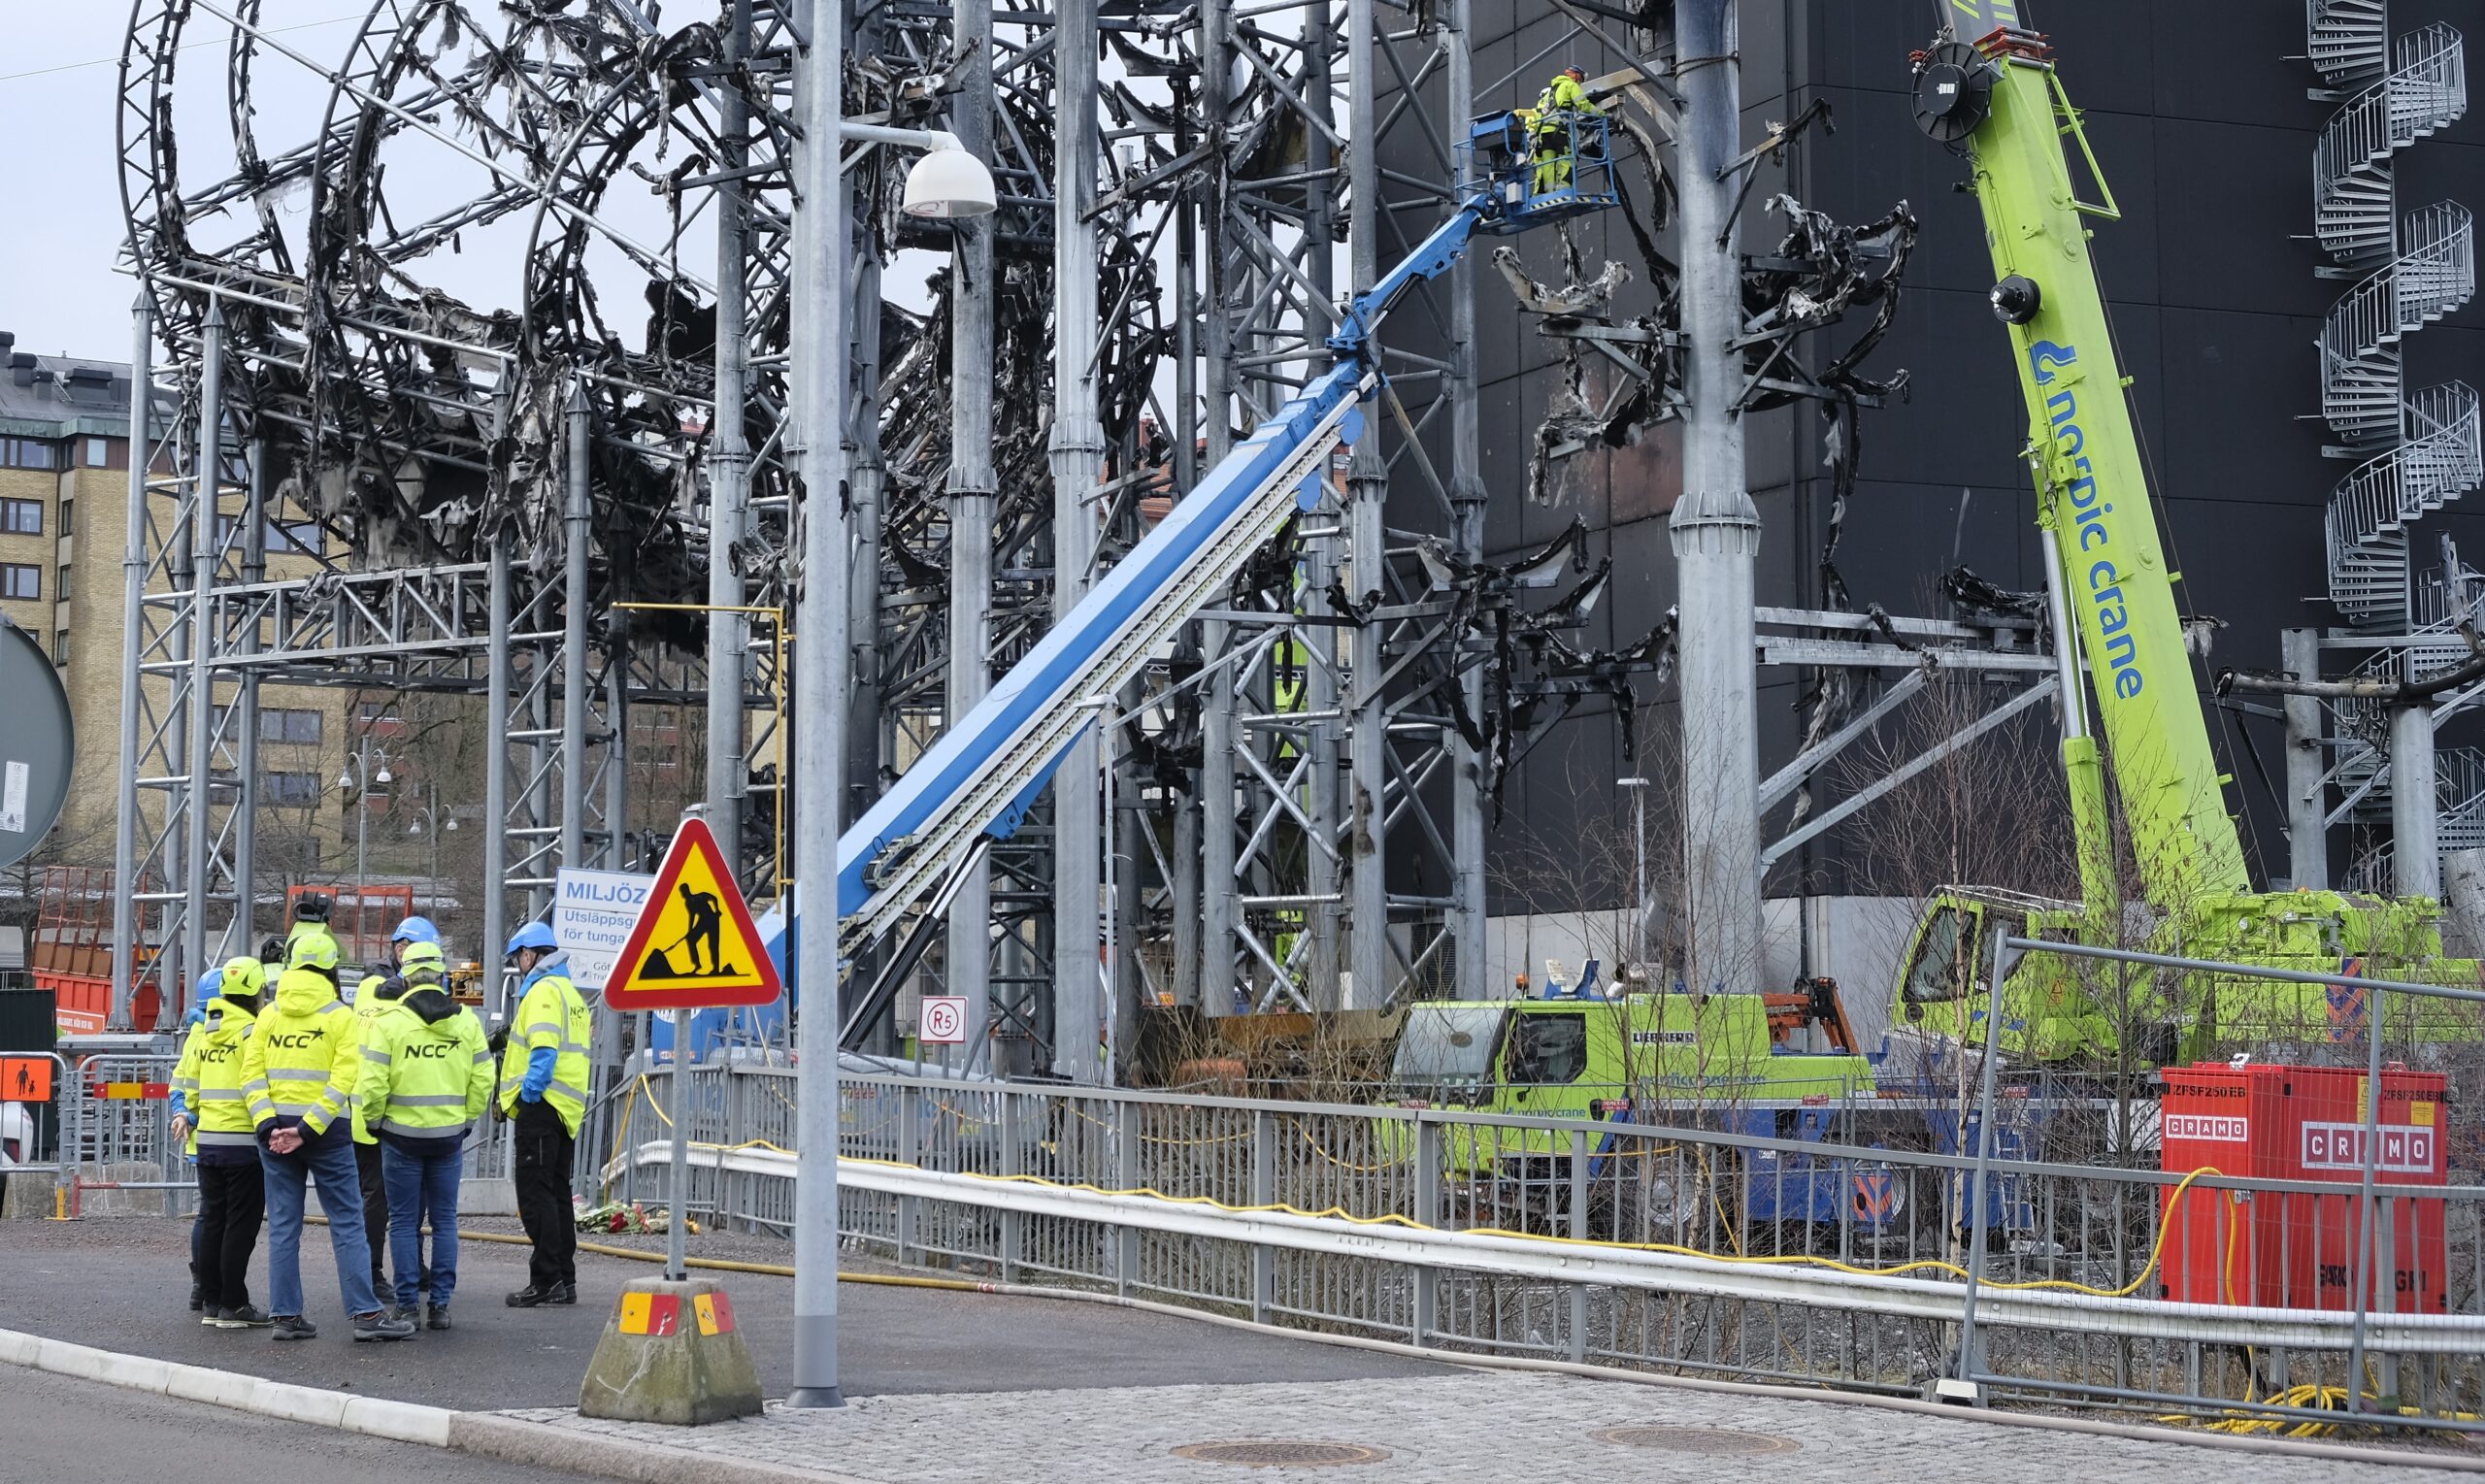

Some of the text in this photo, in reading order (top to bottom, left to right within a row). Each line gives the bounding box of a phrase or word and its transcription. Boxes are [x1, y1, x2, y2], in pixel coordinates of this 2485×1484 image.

[2089, 560, 2144, 700] crane
[563, 927, 626, 946] för tunga
[268, 1035, 311, 1049] NCC
[1633, 1032, 1695, 1043] LIEBHERR
[404, 1044, 447, 1060] NCC
[1556, 1107, 1586, 1118] crane
[2170, 1120, 2243, 1137] CRAMO
[2309, 1134, 2427, 1161] CRMO
